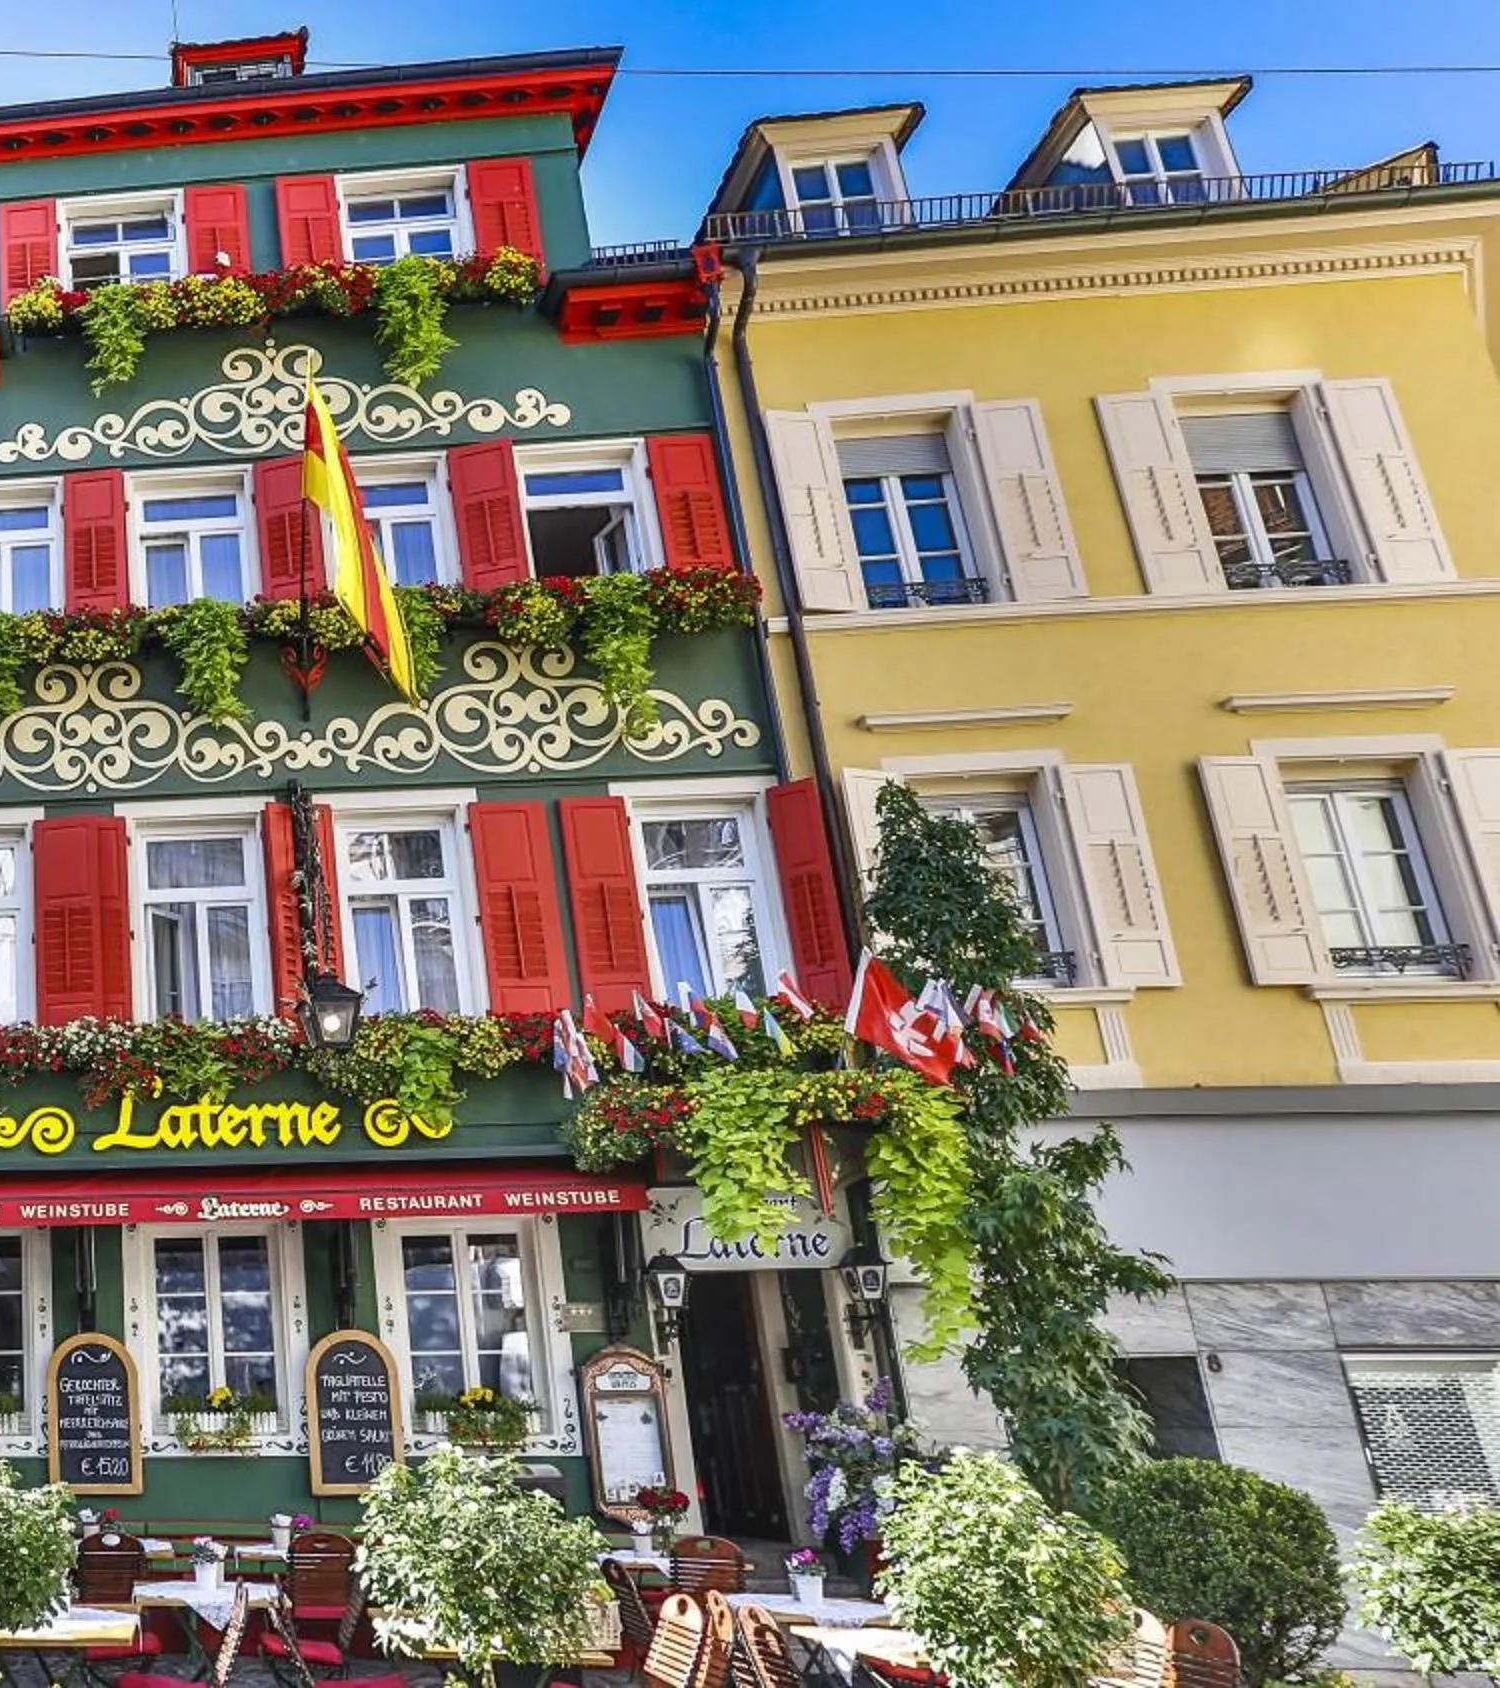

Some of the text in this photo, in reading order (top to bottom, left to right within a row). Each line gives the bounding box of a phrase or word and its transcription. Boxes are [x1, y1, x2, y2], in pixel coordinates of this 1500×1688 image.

[93, 1076, 342, 1151] Laterne
[20, 1203, 129, 1219] WEINSTUBE
[197, 1197, 290, 1220] Laterne
[360, 1190, 621, 1211] RESTAURANT WEINSTUBE
